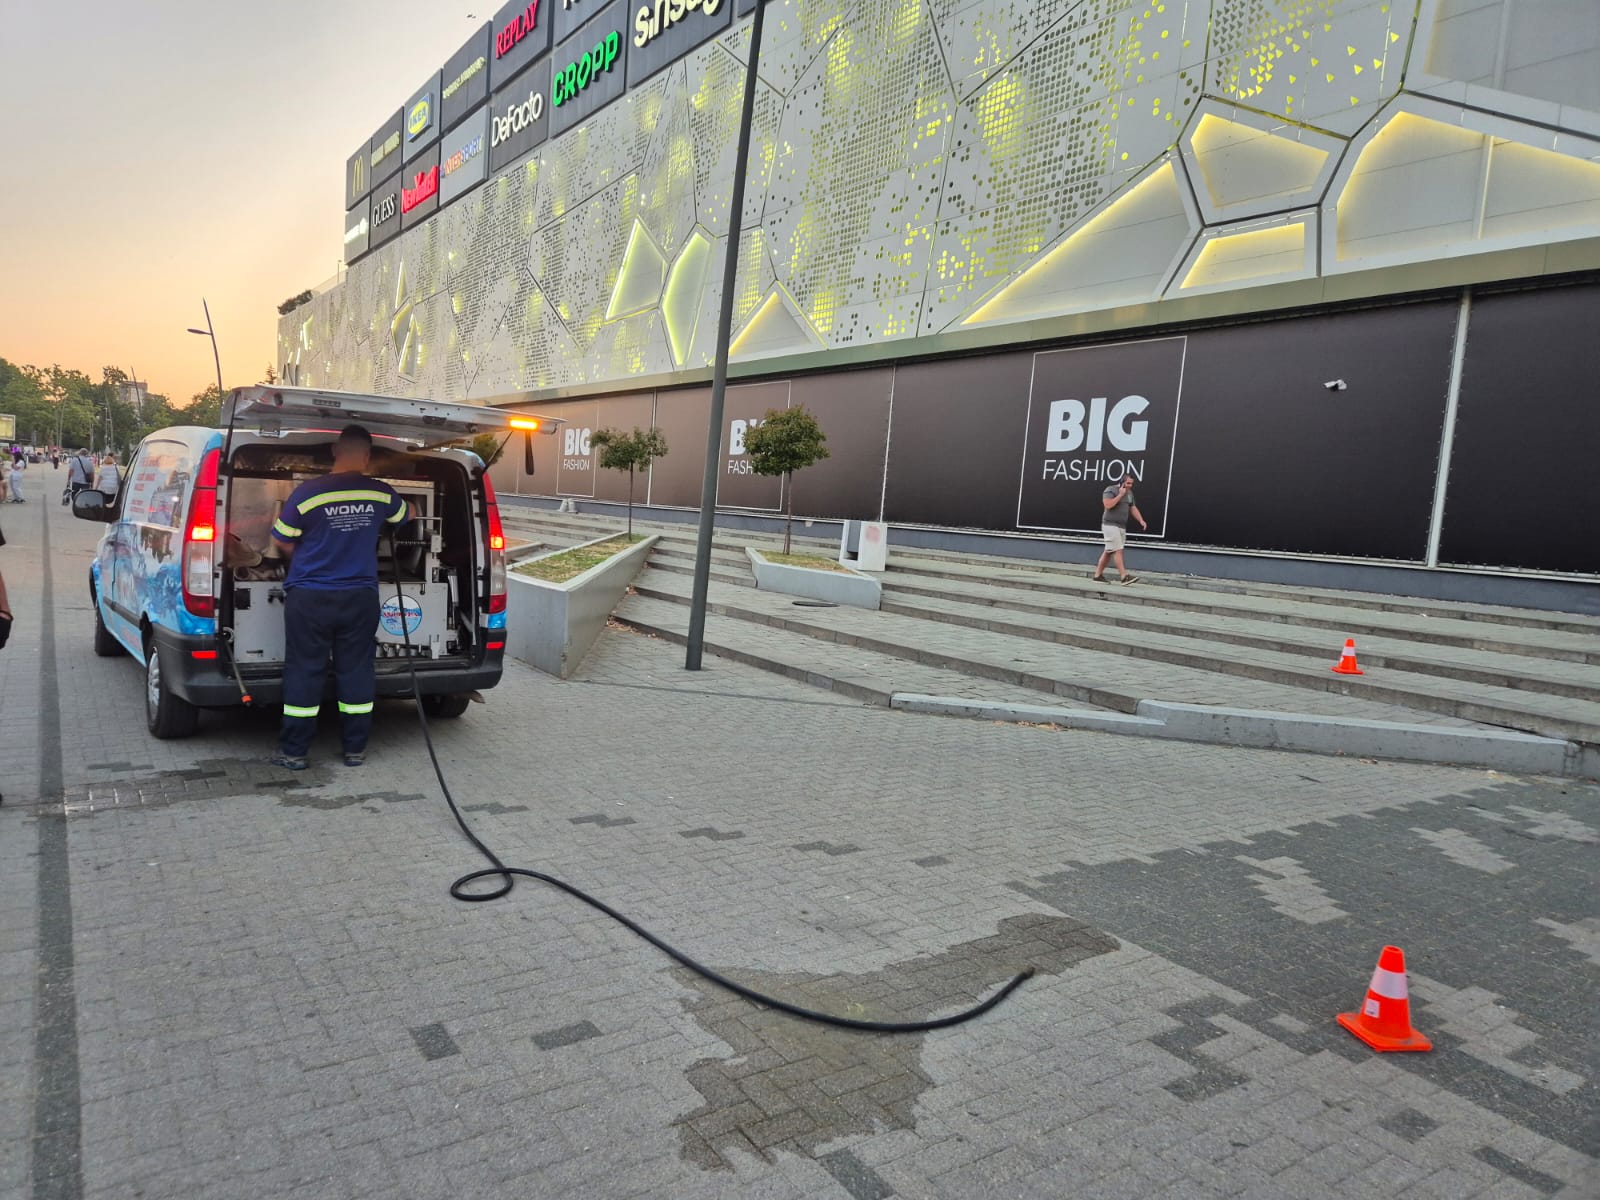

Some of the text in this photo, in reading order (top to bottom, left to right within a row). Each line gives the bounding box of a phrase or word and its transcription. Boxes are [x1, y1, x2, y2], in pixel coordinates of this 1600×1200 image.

[495, 0, 539, 59] REPLAY
[553, 30, 619, 107] CROPP
[491, 91, 543, 147] DeFacto
[372, 193, 396, 227] GUESS
[1045, 395, 1150, 452] BIG
[564, 427, 591, 456] BIG
[563, 459, 590, 471] FASHION
[1042, 459, 1145, 482] FASHION
[324, 504, 375, 516] WOMA
